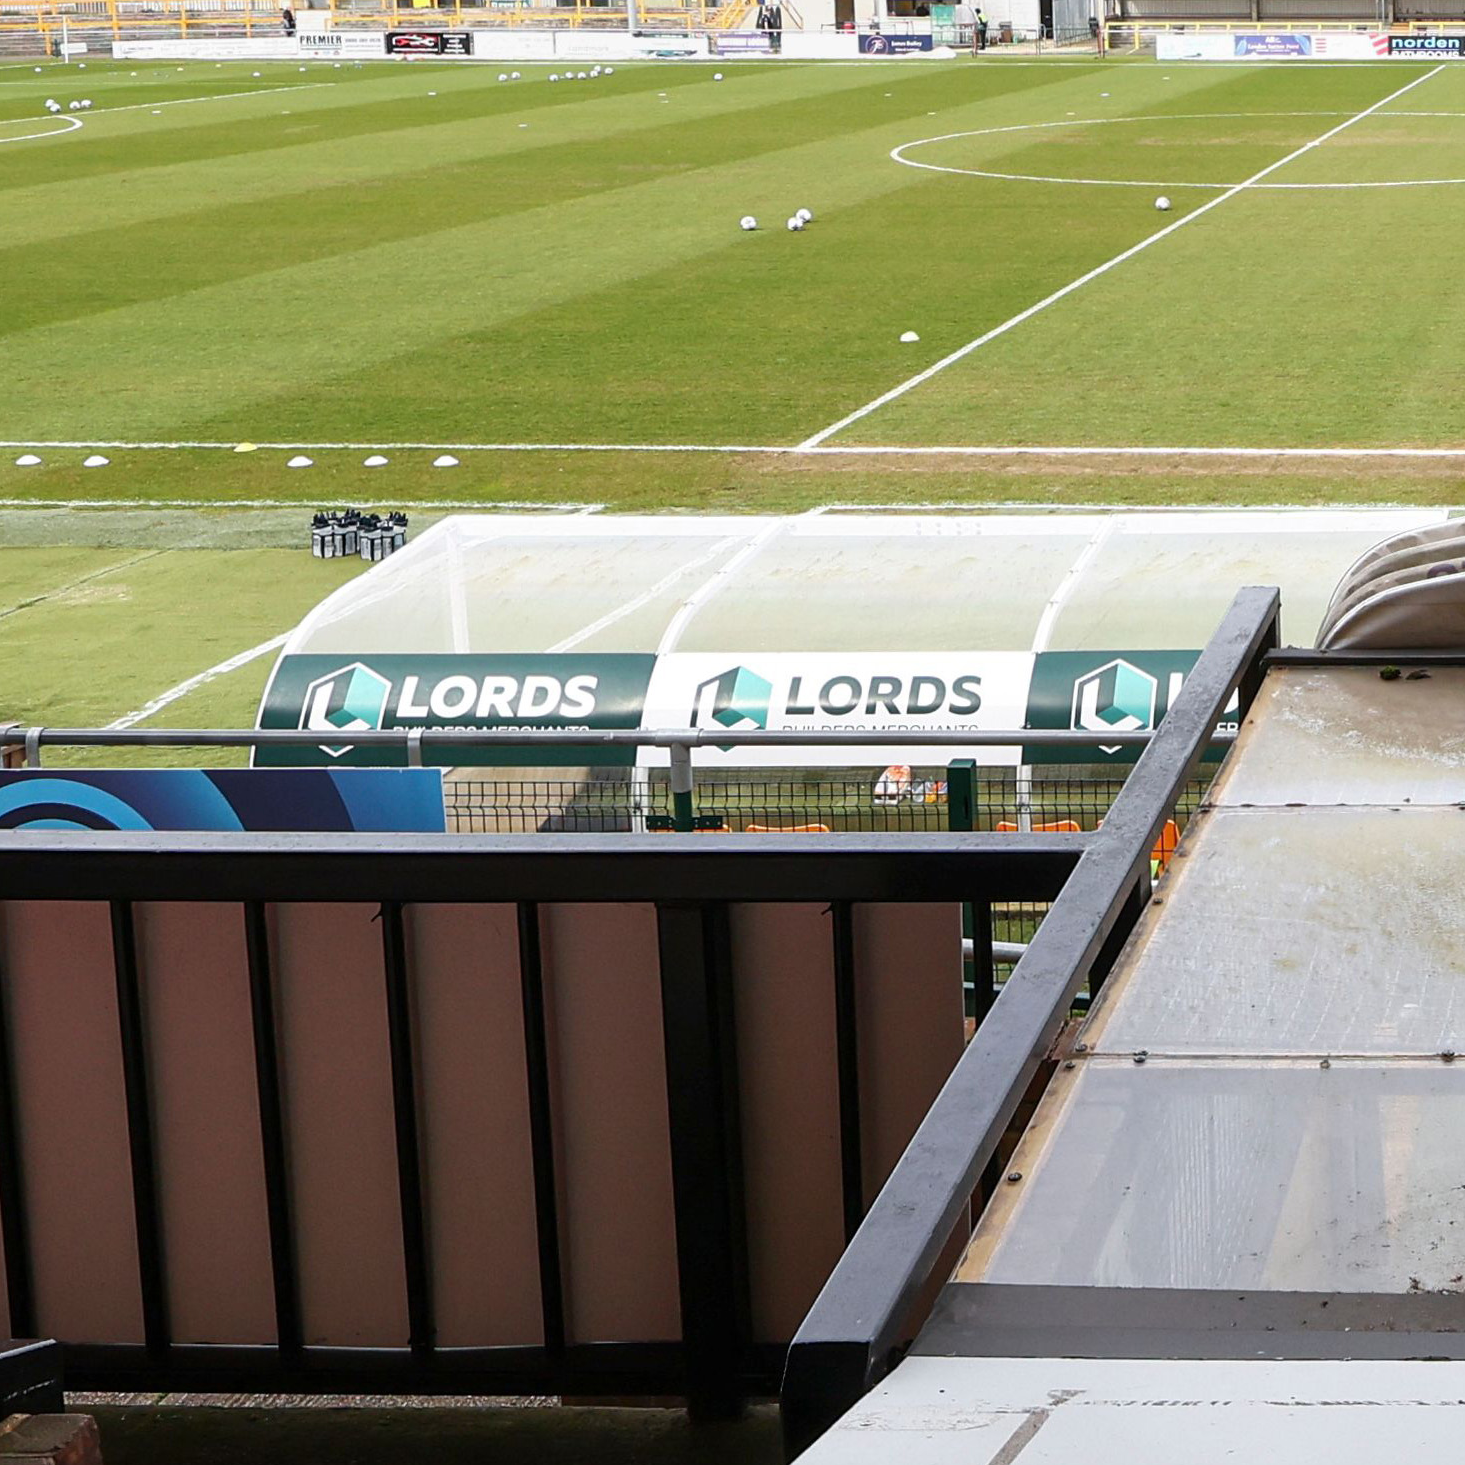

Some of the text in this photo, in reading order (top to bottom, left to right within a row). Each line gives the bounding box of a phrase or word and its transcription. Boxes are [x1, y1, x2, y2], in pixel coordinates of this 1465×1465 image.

[299, 35, 342, 45] PREMIER
[1392, 37, 1460, 47] norden
[396, 675, 598, 718] LORDS
[785, 675, 982, 716] LORDS
